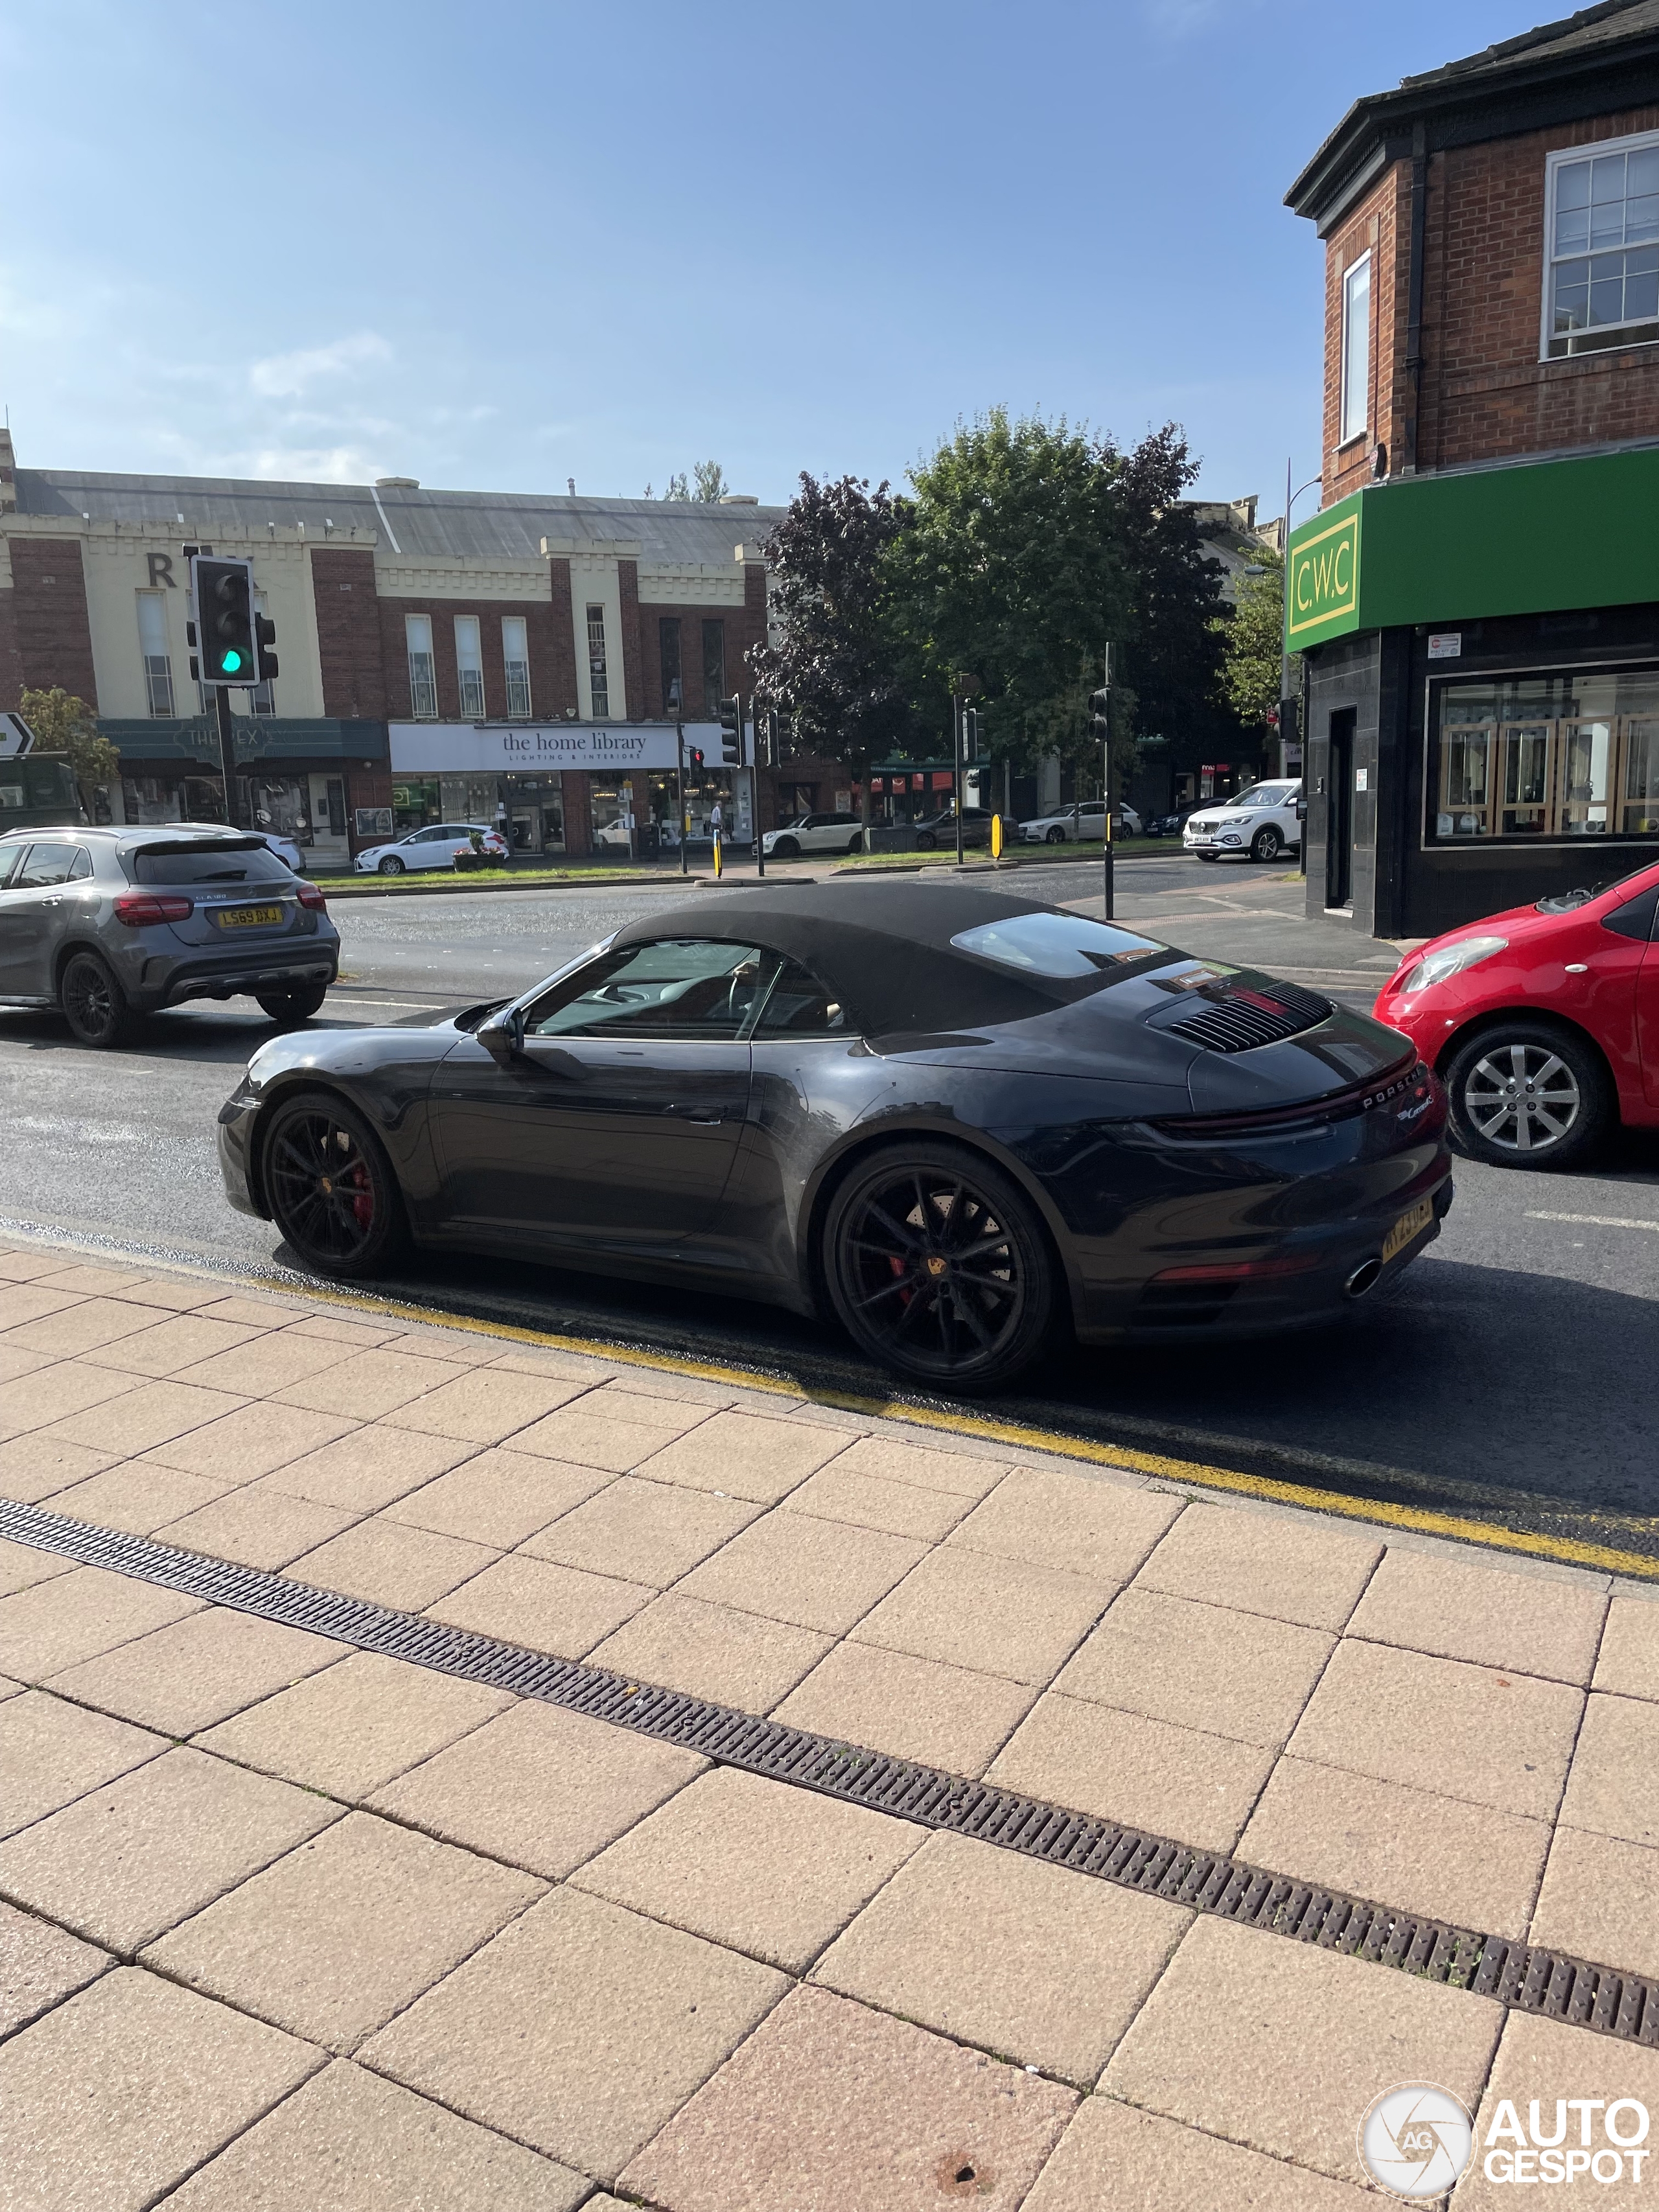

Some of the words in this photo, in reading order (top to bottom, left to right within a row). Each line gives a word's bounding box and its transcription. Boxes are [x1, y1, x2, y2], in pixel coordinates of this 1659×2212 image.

[191, 729, 218, 745] THE
[233, 729, 258, 745] EX
[504, 733, 530, 751] the
[536, 733, 586, 751] home
[592, 732, 647, 753] library
[223, 911, 254, 926] LS69
